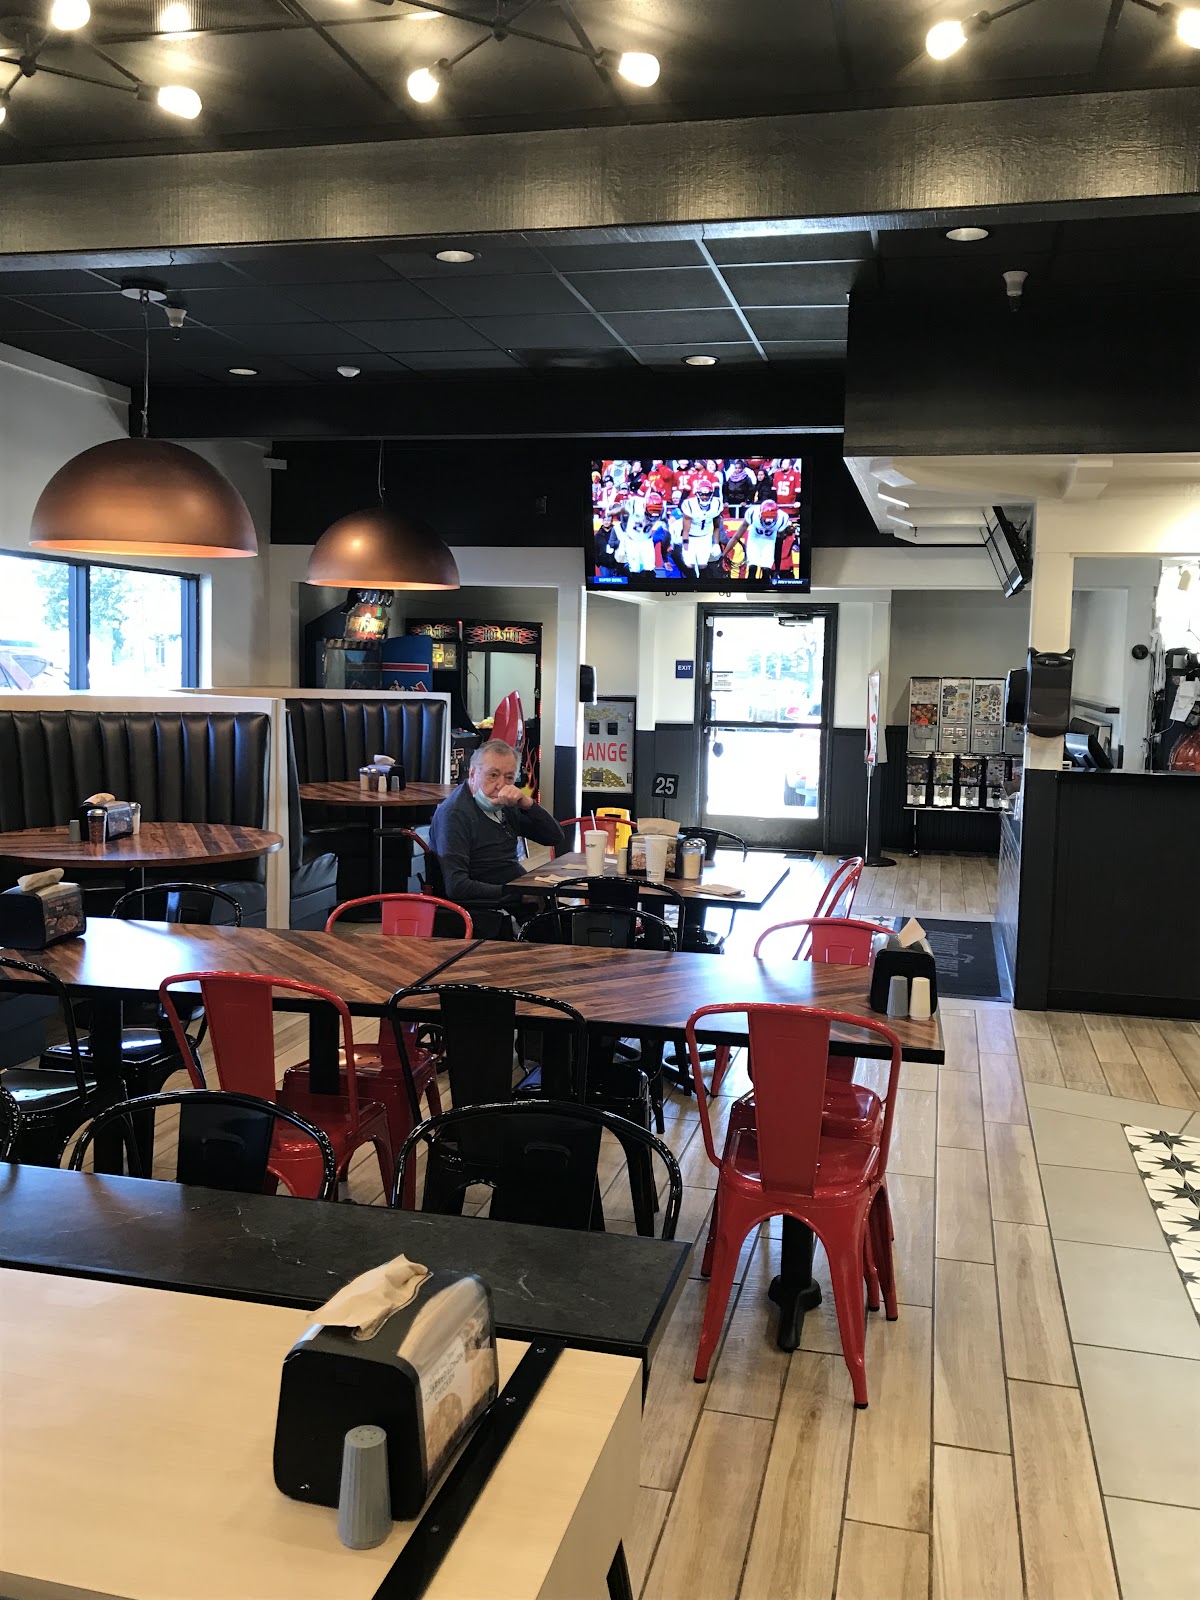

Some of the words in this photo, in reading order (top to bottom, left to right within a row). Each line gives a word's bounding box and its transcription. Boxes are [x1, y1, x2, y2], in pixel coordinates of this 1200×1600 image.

[777, 481, 790, 496] 15
[483, 629, 499, 641] HOT
[582, 742, 628, 762] ANGE
[655, 776, 675, 795] 25
